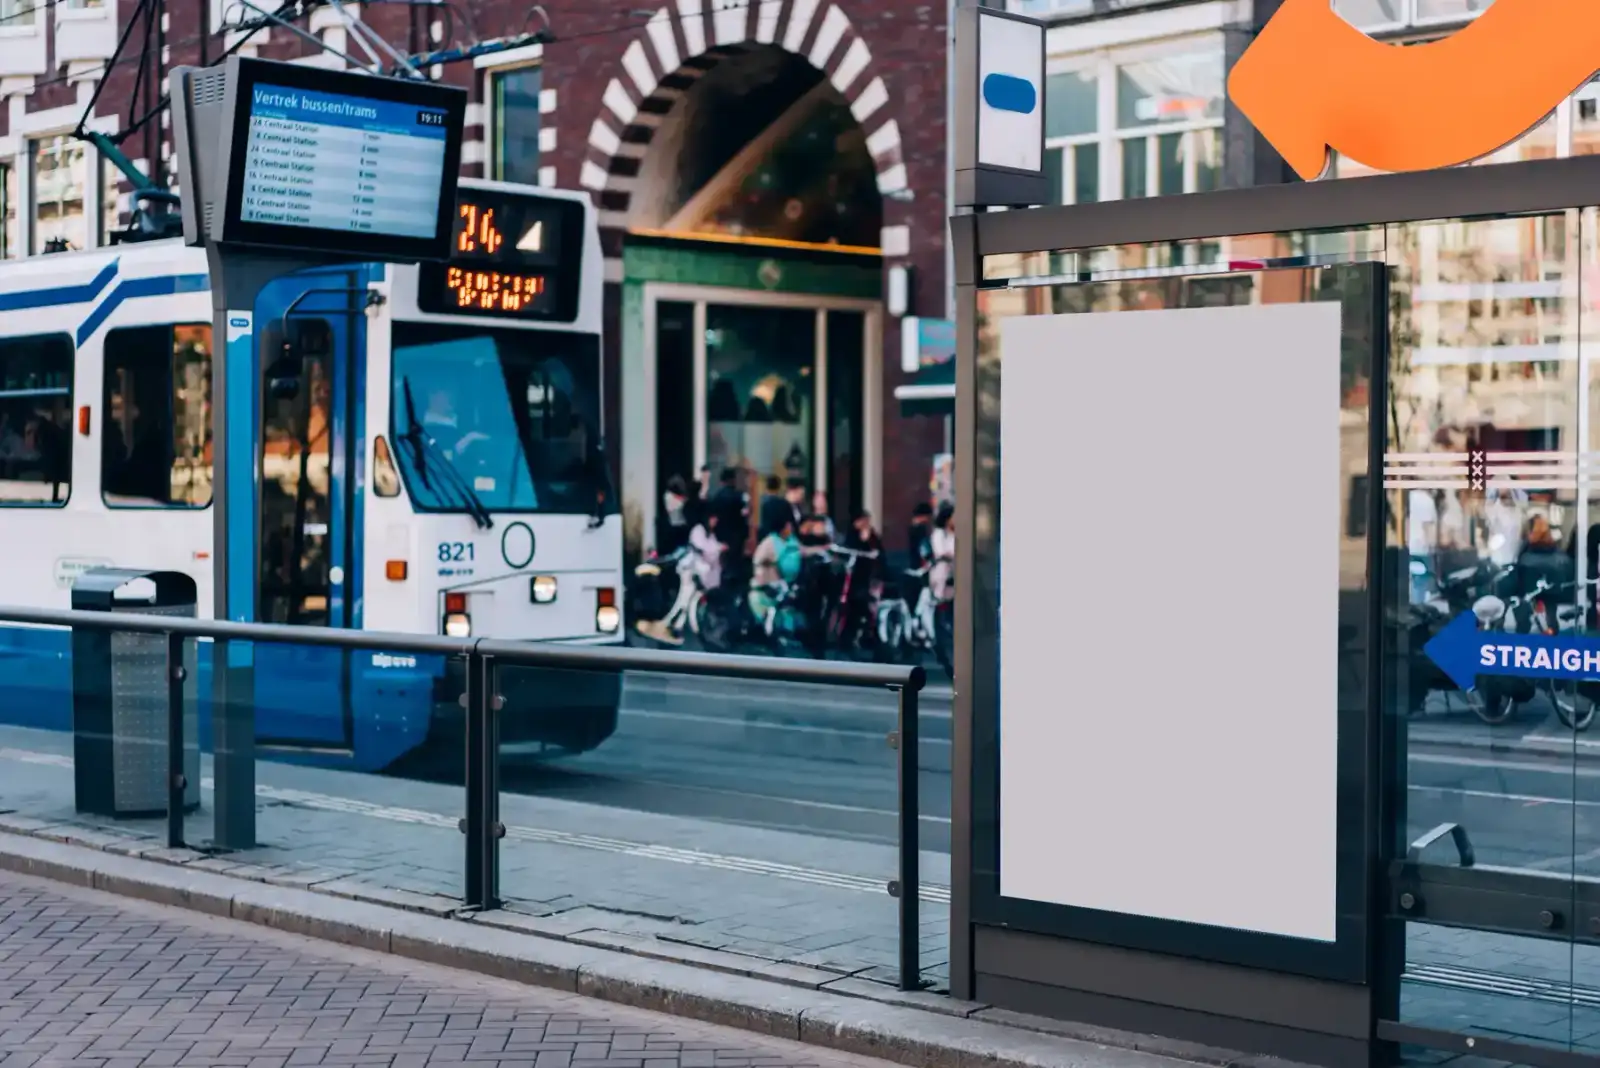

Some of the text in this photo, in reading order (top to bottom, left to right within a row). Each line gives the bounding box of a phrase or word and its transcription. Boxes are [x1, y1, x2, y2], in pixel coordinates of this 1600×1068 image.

[254, 90, 298, 108] Vertrek
[302, 96, 377, 119] bussen/trams
[420, 112, 443, 125] 19:11
[263, 120, 293, 129] Centraal
[295, 123, 318, 132] Station
[263, 132, 292, 143] Centraal
[293, 137, 318, 146] Station
[262, 146, 290, 156] Centraal
[293, 149, 316, 158] Station
[260, 159, 289, 169] Centraal
[291, 162, 315, 172] Station
[259, 173, 288, 182] Centraal
[290, 175, 313, 185] Station
[258, 185, 287, 195] Centraal
[288, 189, 312, 198] Station
[256, 198, 286, 208] Centraal
[287, 202, 311, 210] Station
[255, 211, 284, 221] Centraal
[286, 215, 310, 223] Station
[437, 541, 474, 562] 821
